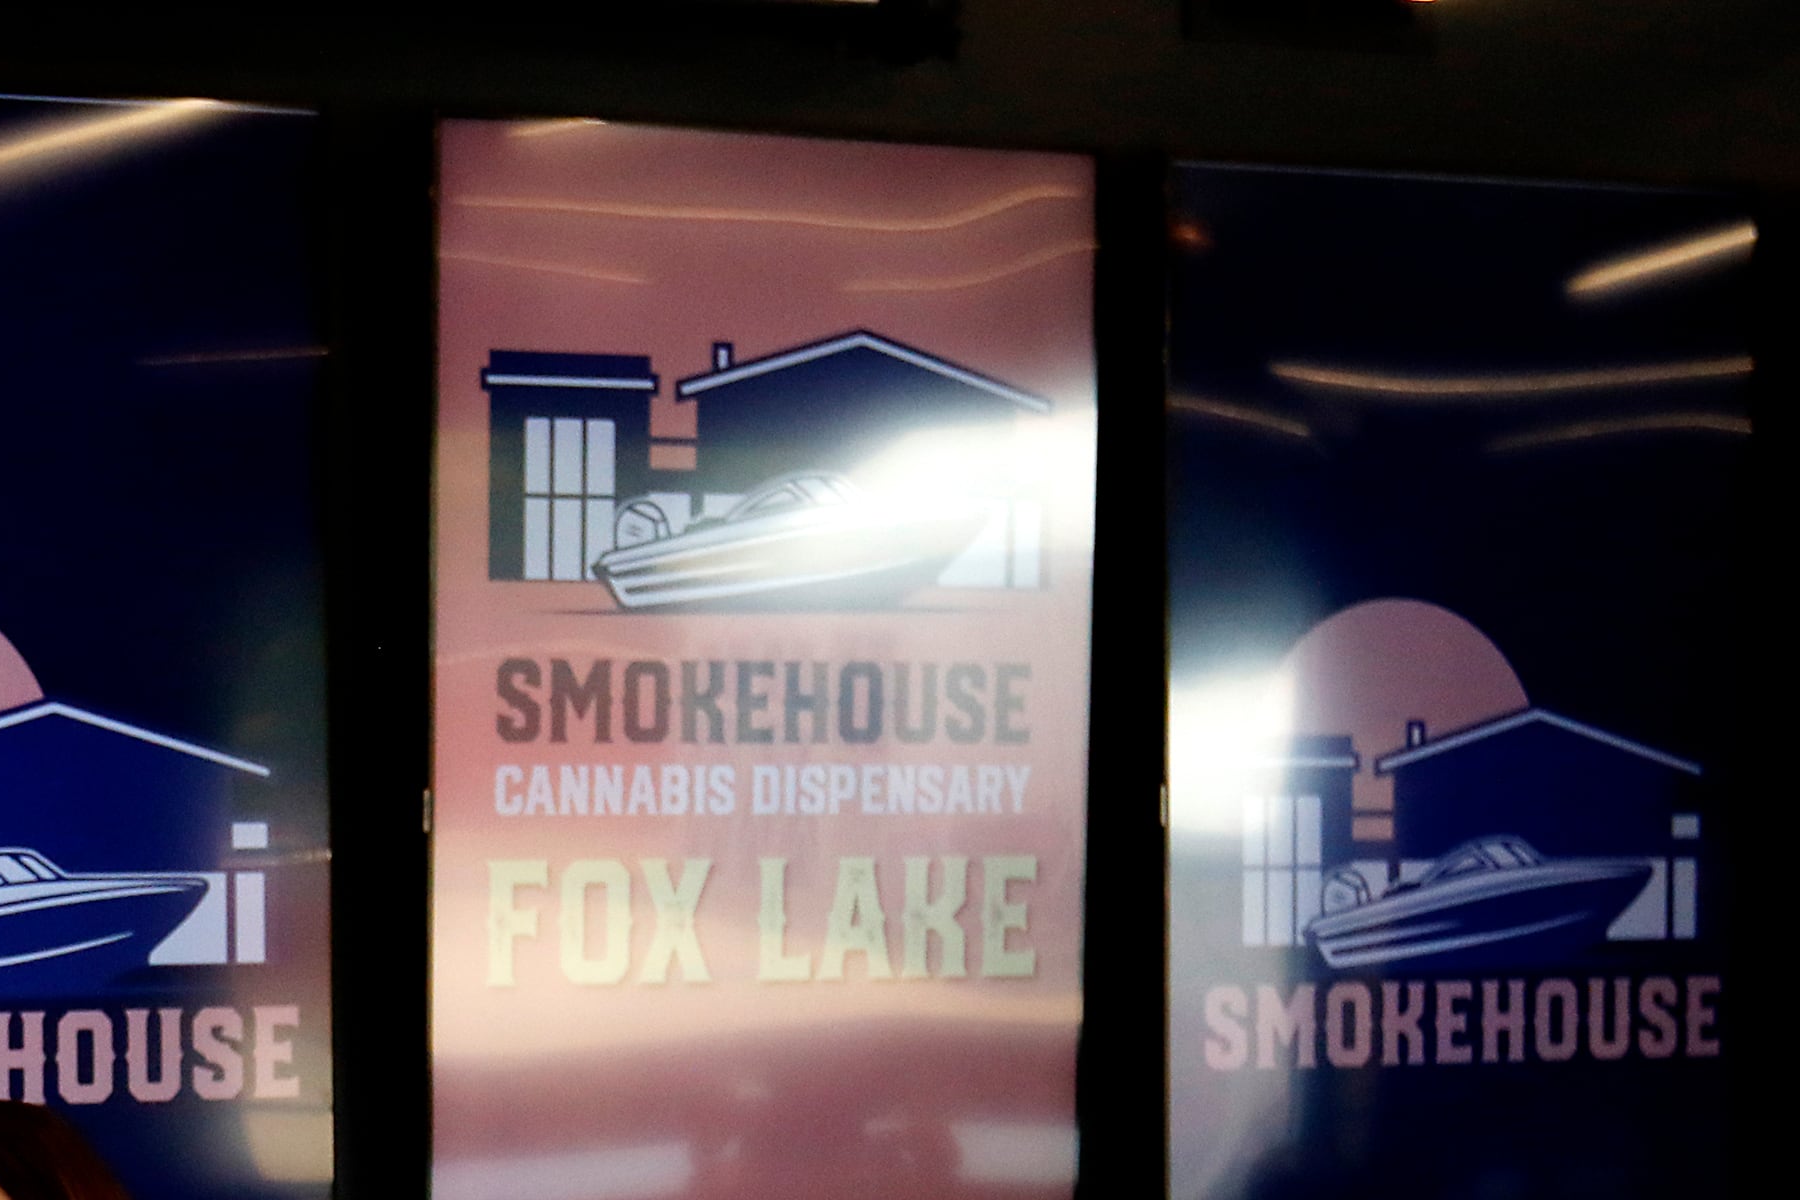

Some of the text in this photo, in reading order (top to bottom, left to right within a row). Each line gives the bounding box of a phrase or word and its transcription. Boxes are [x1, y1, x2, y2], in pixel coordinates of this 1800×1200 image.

[495, 658, 1033, 745] SMOKEHOUSE
[494, 764, 1032, 815] CANNABIS DISPENSARY
[486, 855, 1038, 987] FOX LAKE
[1203, 976, 1722, 1071] SMOKEHOUSE
